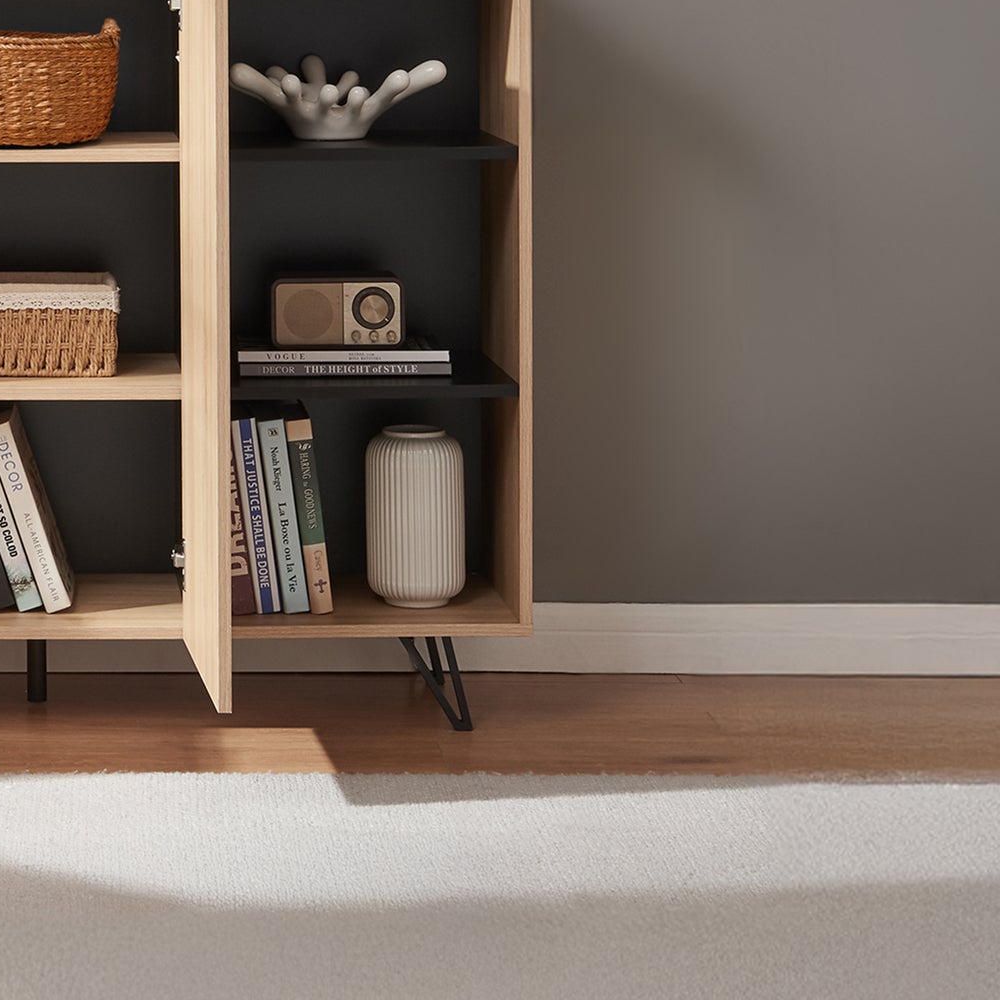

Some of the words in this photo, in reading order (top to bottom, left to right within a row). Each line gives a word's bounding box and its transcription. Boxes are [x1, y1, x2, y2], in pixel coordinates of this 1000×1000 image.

[266, 353, 306, 361] VOGUE
[262, 366, 295, 375] DECOR
[304, 365, 327, 374] THE
[328, 364, 371, 374] HEIGHT
[372, 365, 382, 374] of
[383, 364, 419, 374] STYLE
[242, 438, 256, 467] THAT
[270, 446, 280, 467] Noah
[246, 469, 261, 512] JUSTICE
[277, 502, 288, 517] La
[251, 514, 265, 546] SHALL
[280, 518, 290, 545] Boxe
[2, 529, 18, 558] COLOD
[255, 546, 267, 559] BE
[283, 546, 292, 561] ou
[23, 511, 50, 576] ALL-AMERICAN
[46, 577, 61, 602] FLAIR
[257, 560, 270, 589] DONE
[286, 562, 296, 574] la
[287, 574, 298, 593] Vie
